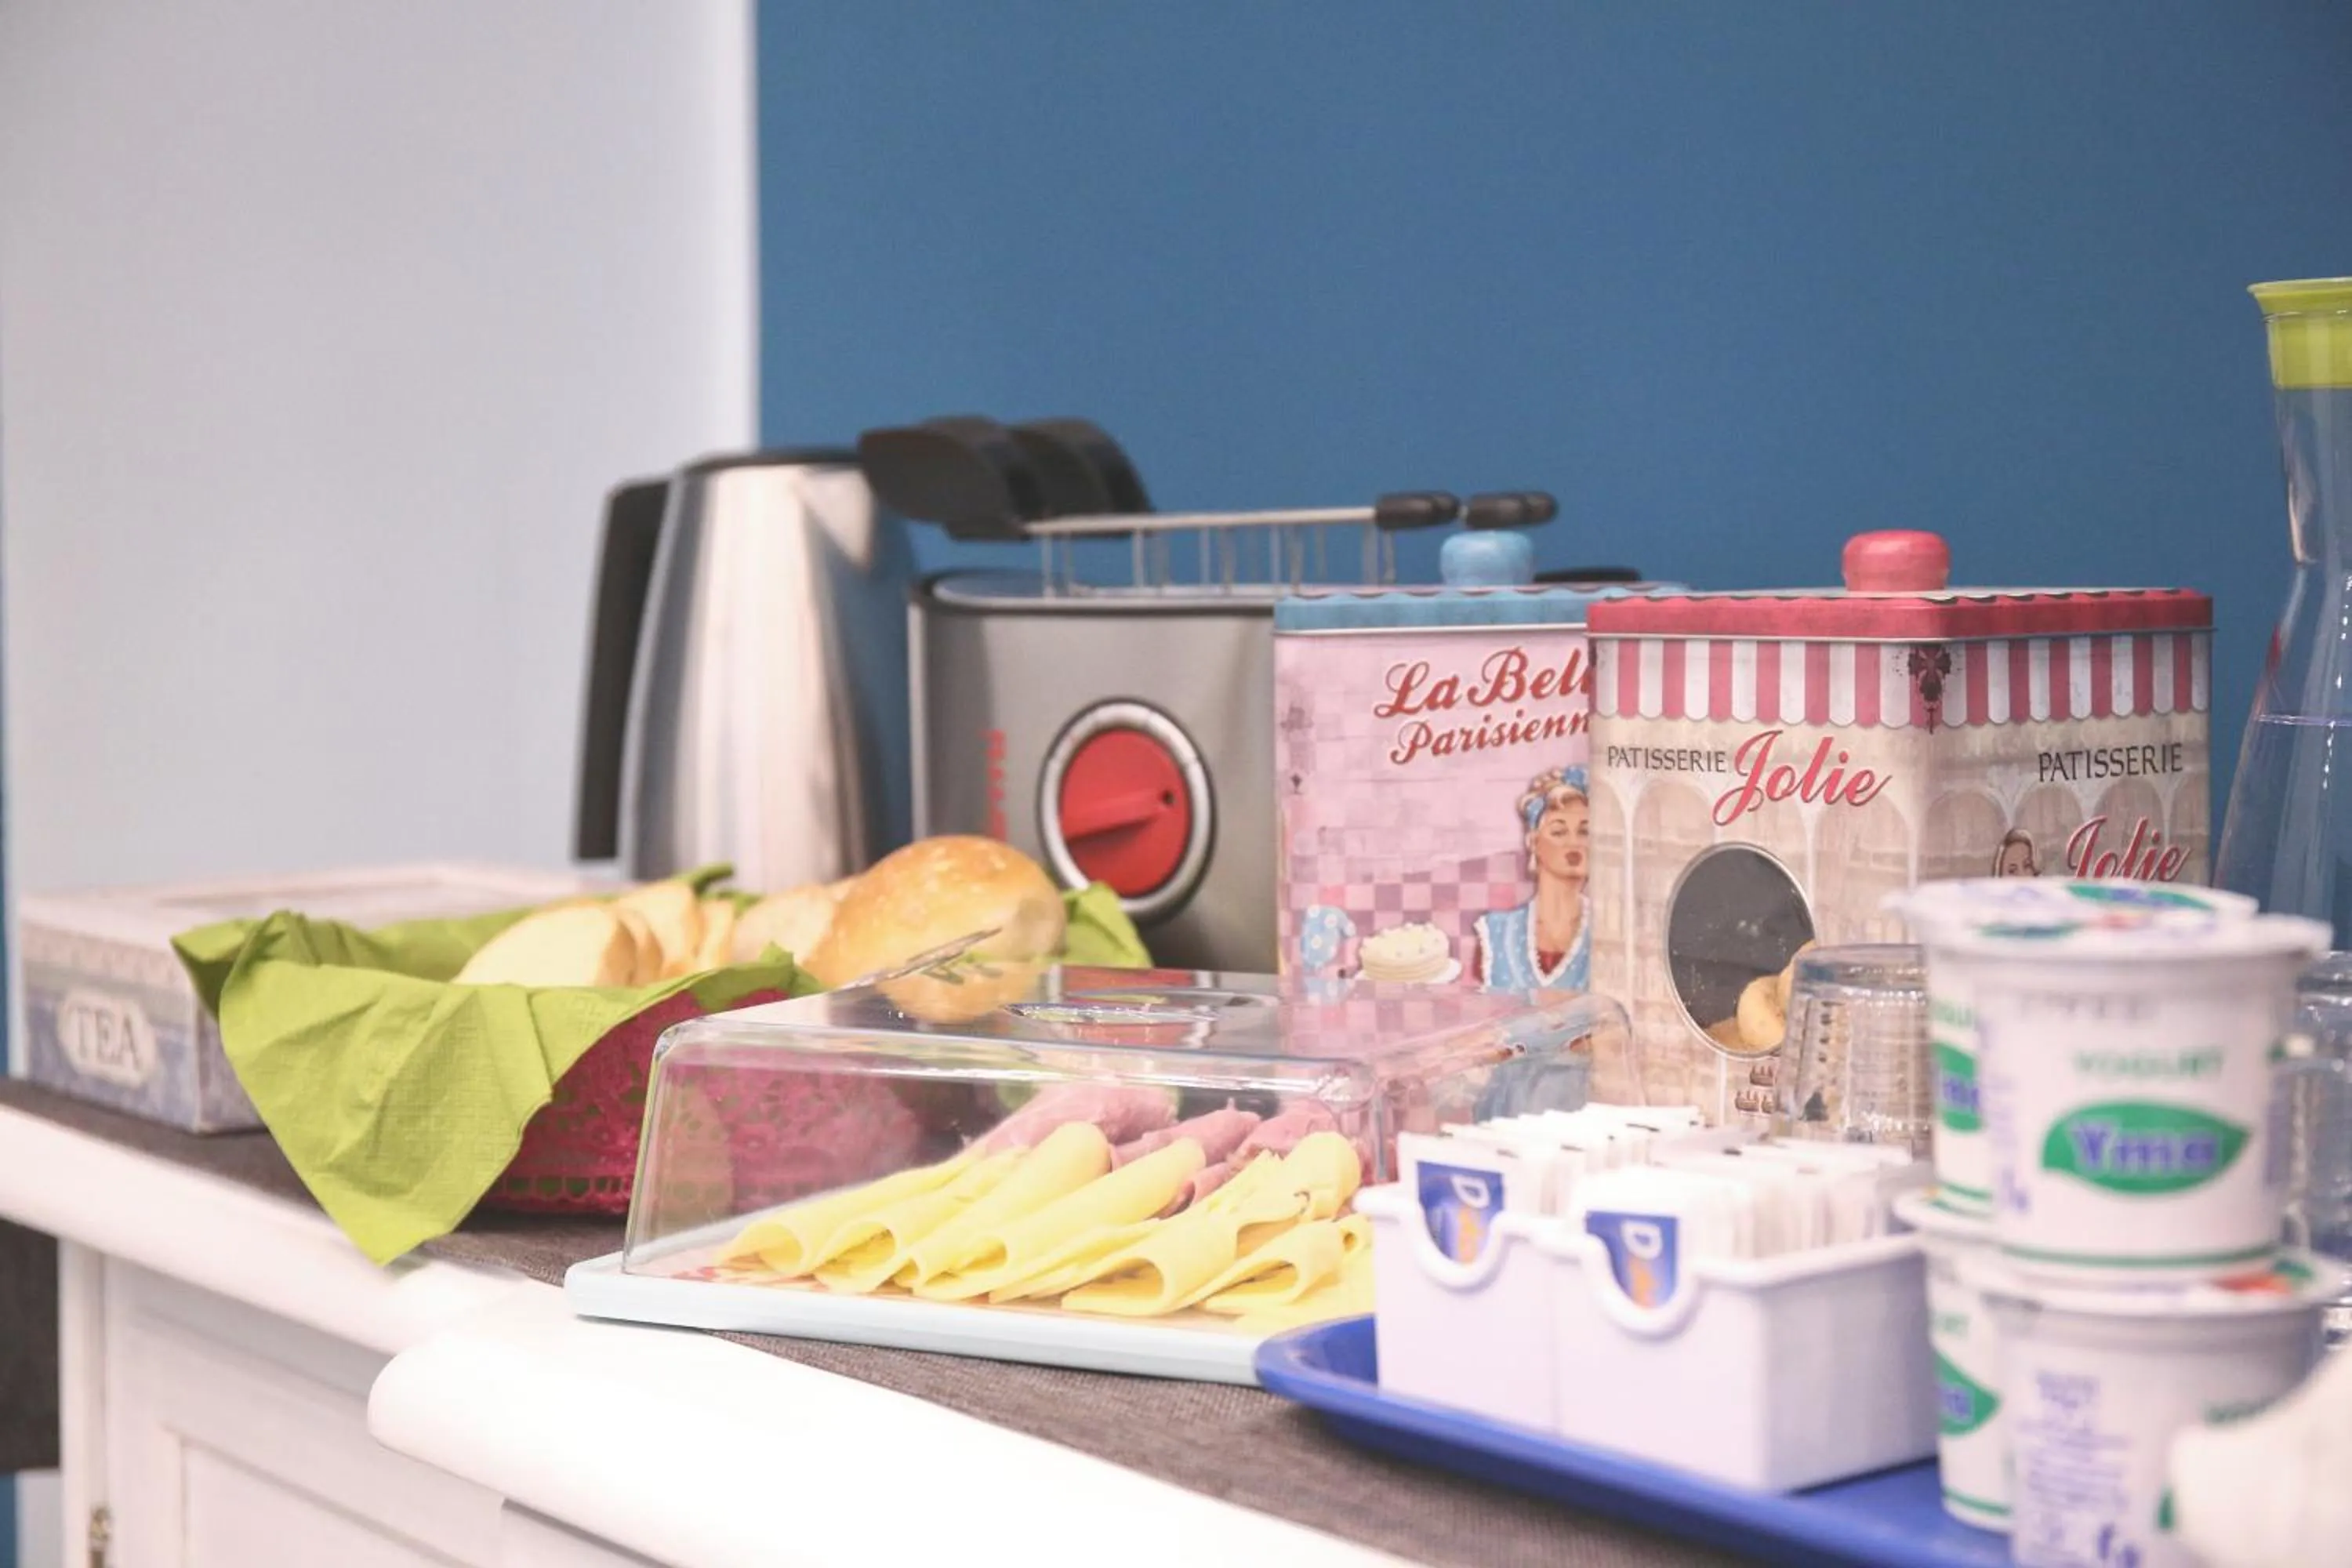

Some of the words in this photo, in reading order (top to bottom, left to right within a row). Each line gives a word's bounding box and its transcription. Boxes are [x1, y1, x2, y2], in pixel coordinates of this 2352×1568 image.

[1374, 661, 1463, 718] La
[1606, 745, 1727, 773] PATISSERIE
[1712, 730, 1893, 826] Jolie
[2038, 742, 2183, 782] PATISSERIE
[2066, 815, 2192, 882] Jolie
[67, 1002, 143, 1073] TEA
